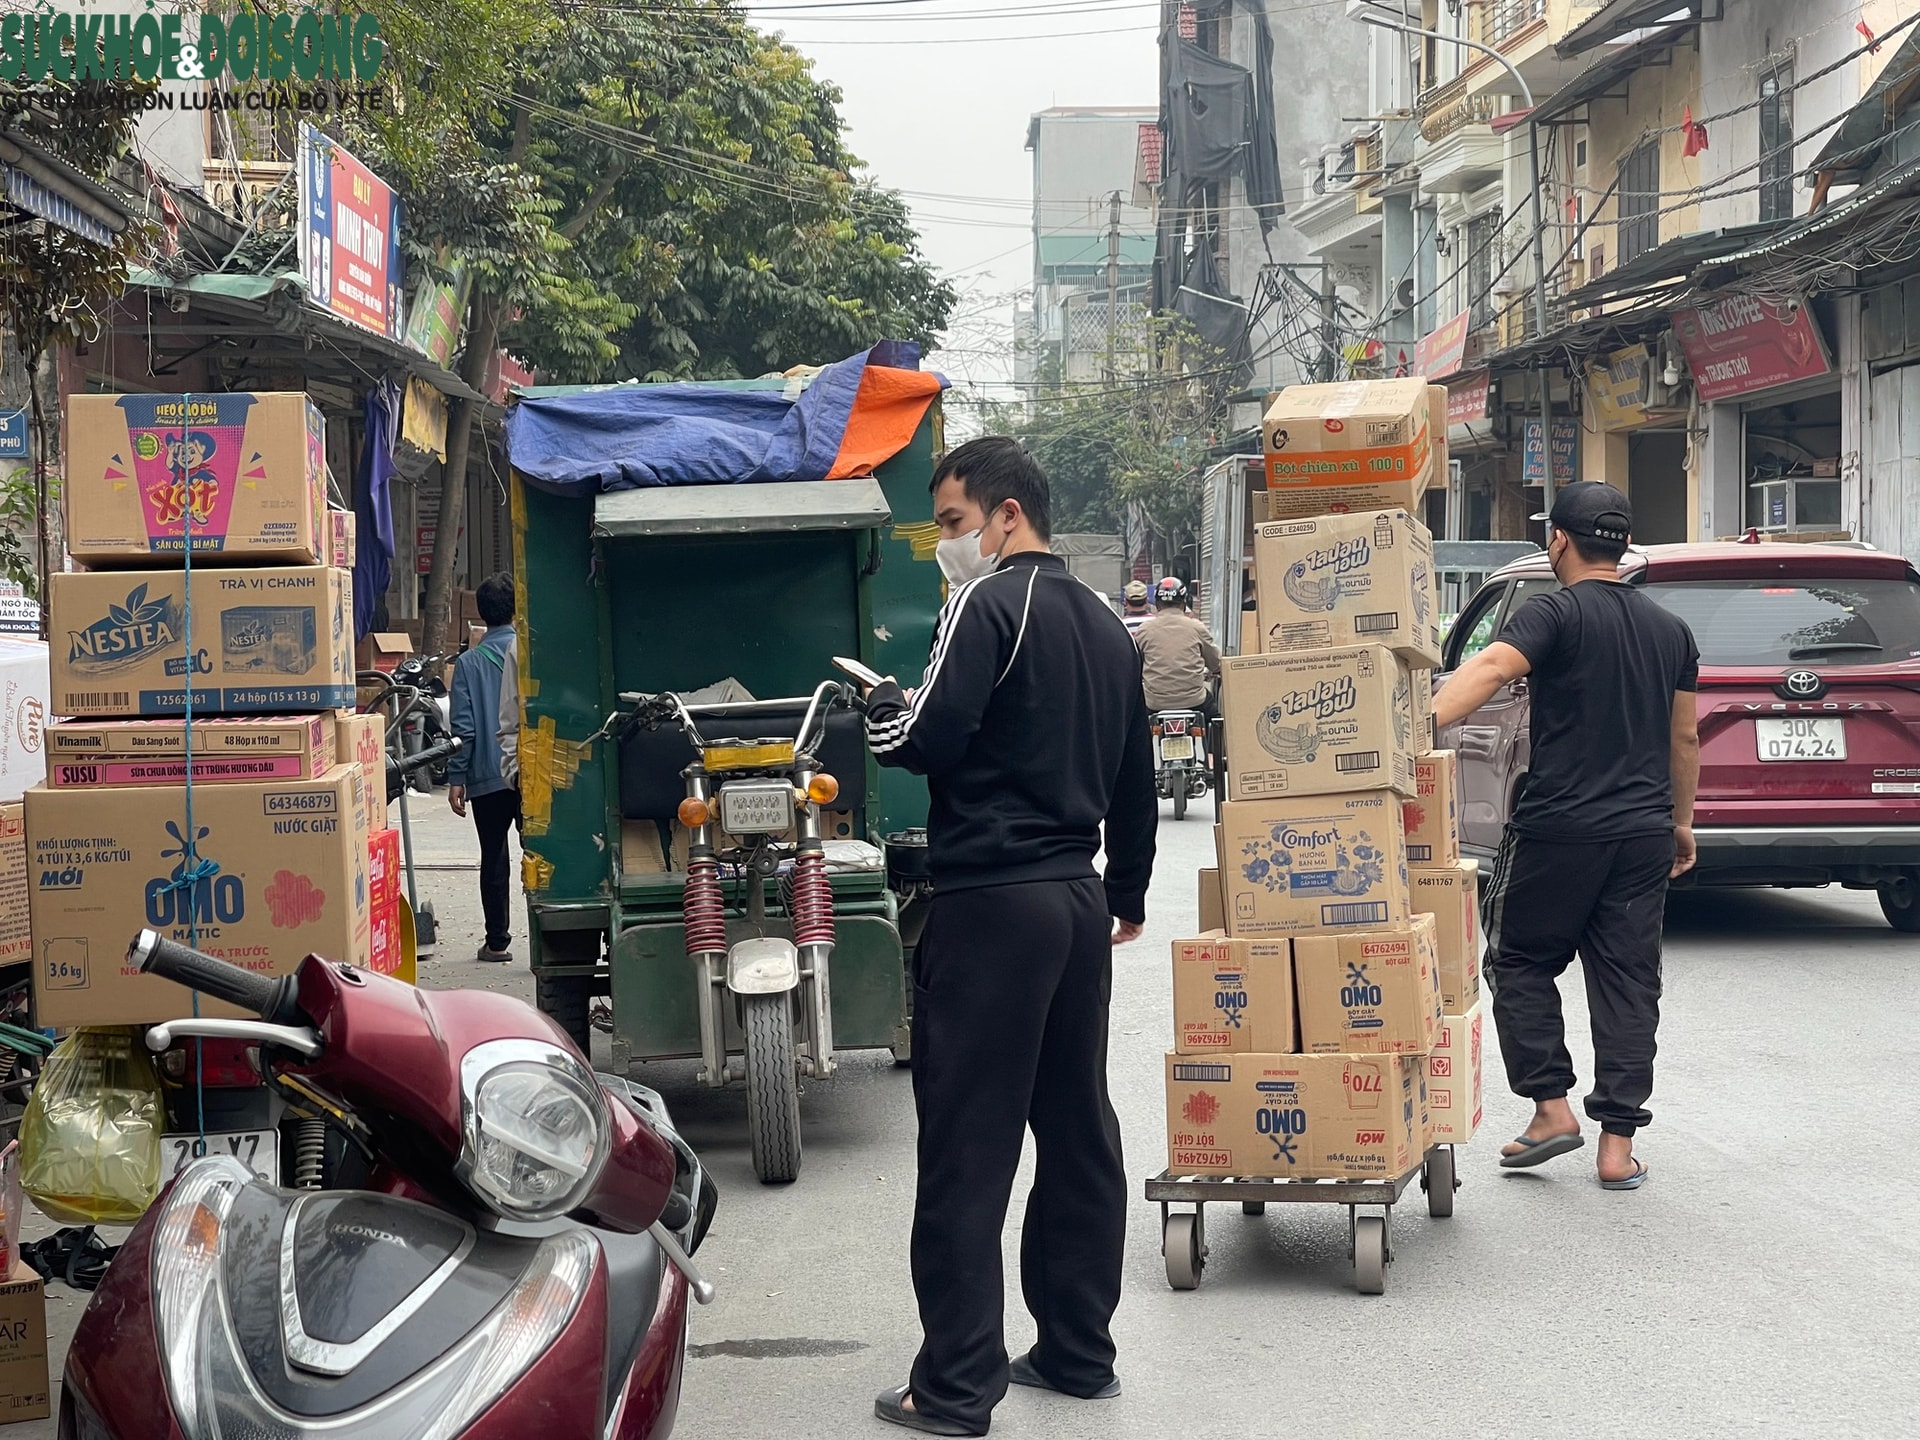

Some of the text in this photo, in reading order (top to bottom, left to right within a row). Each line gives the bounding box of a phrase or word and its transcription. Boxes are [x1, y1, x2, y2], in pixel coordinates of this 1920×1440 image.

[337, 201, 384, 270] MINH THỦY
[1722, 294, 1764, 329] COFFEE
[156, 403, 176, 416] HEO
[1274, 458, 1404, 477] Bột chiên xù 100 g
[1265, 524, 1314, 536] CODE E240256
[219, 576, 316, 591] TRÀ VỊ CHANH
[68, 621, 177, 658] NESTEA
[229, 632, 267, 648] NESTEA
[233, 690, 320, 705] 24 hộp (15 x 13 g)
[26, 701, 43, 747] Pure
[1782, 719, 1819, 737] 30K
[57, 736, 102, 747] Vinamilk
[224, 735, 280, 747] 48 Hộp x 110 ml
[1768, 739, 1836, 757] 074.24
[62, 766, 97, 784] SUSU
[146, 767, 166, 777] CHUA
[269, 795, 331, 810] 64346879
[1345, 800, 1384, 808] 64774702
[274, 816, 338, 835] NƯỚC GIẶT
[36, 838, 117, 851] KHỐI LƯỢNG TỊNH:
[1281, 827, 1341, 849] Comfort
[37, 848, 131, 865] 4 TÚI X 3,6 KG/TÚI
[40, 866, 83, 886] MỚI
[1417, 878, 1453, 886] 64811767
[144, 874, 245, 927] OMO
[173, 928, 221, 940] MATIC
[227, 945, 269, 957] TRƯỚC
[1364, 943, 1406, 954] 64762494
[247, 958, 274, 970] MỐC
[1385, 958, 1397, 966] BỘT
[50, 962, 82, 978] 3,6 kg
[1214, 991, 1248, 1009] OMO
[1340, 985, 1382, 1008] OMO
[1187, 1034, 1228, 1044] 64762496
[1342, 1071, 1383, 1092] 770 g
[1256, 1108, 1306, 1135] OMO
[1172, 1131, 1215, 1148] BỘT GIẶT
[1355, 1132, 1385, 1146] MỚI
[1177, 1152, 1228, 1165] 64762494
[1345, 1155, 1359, 1163] 770
[1364, 1153, 1376, 1163] gói
[1376, 1155, 1385, 1163] 18
[333, 1223, 407, 1248] HONDA
